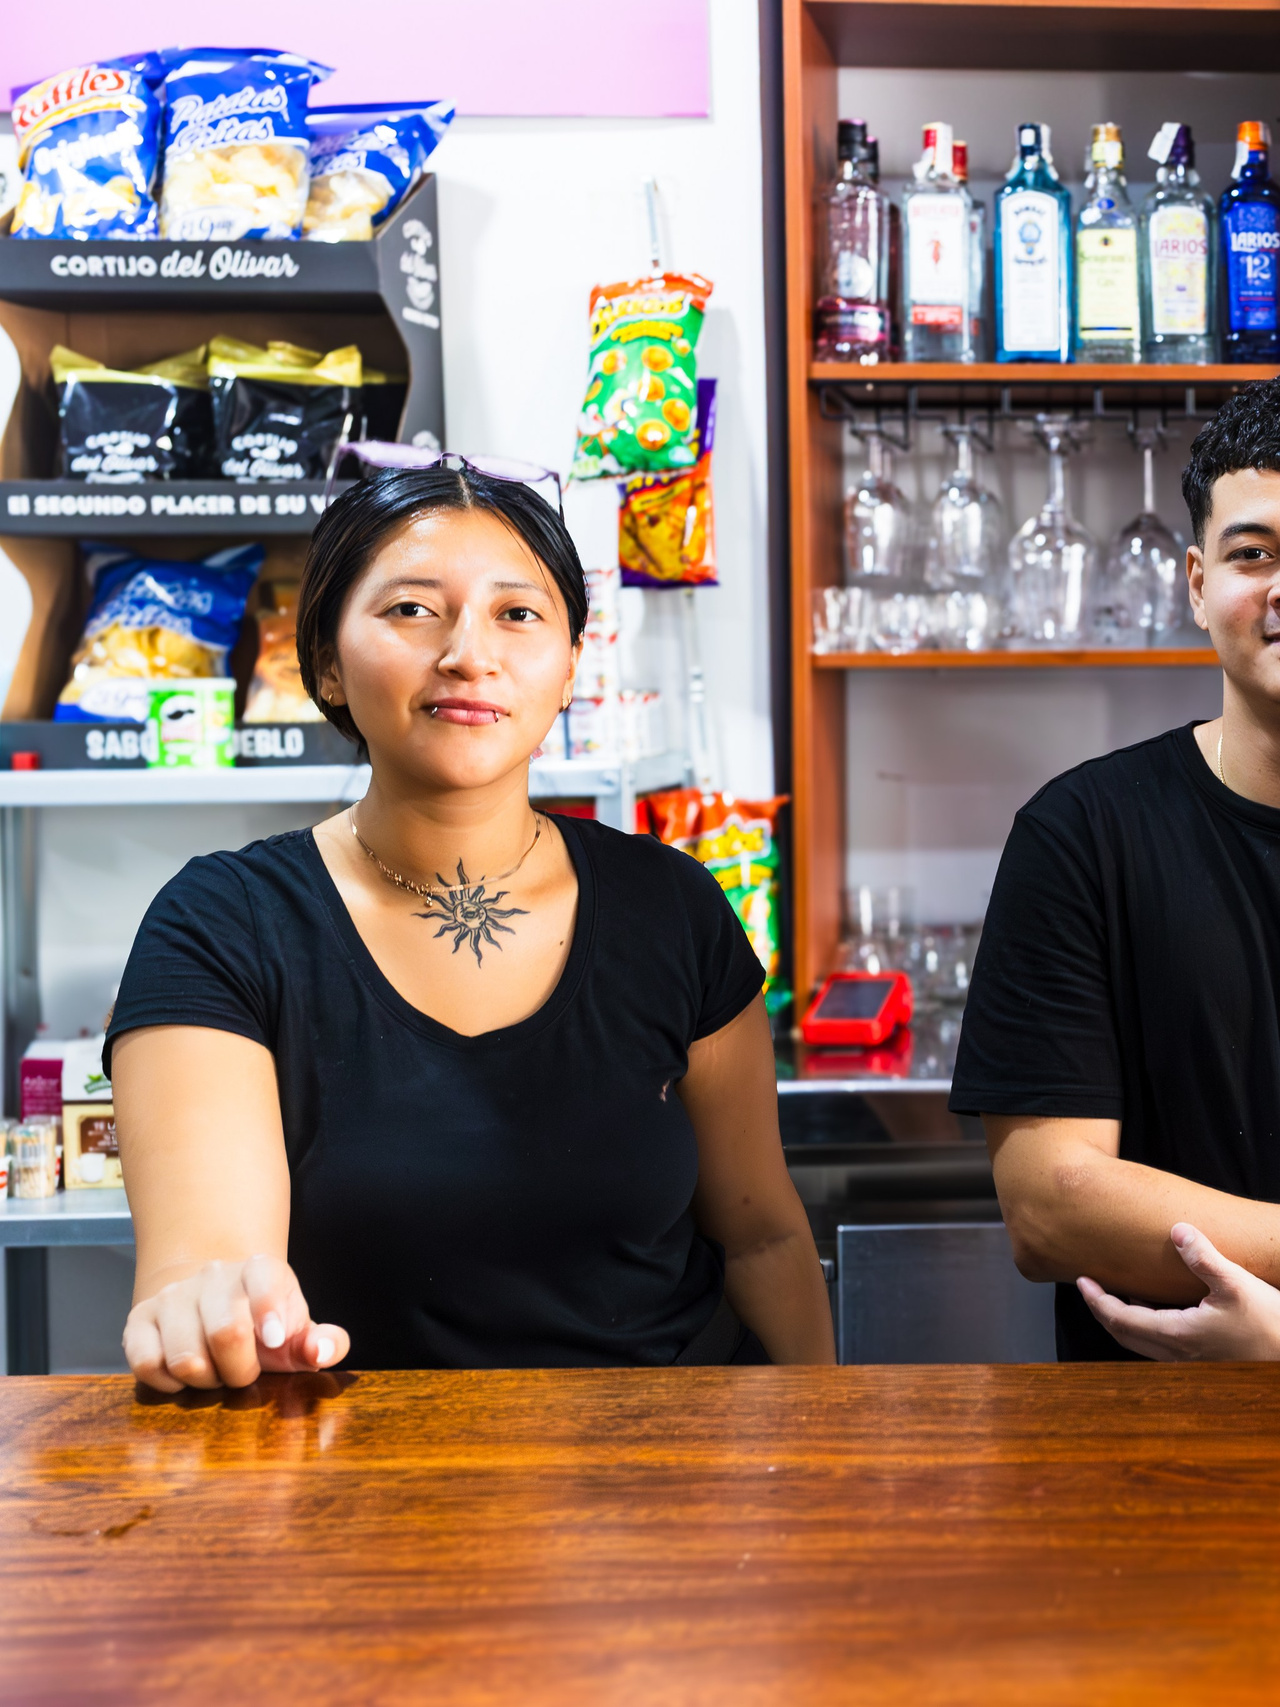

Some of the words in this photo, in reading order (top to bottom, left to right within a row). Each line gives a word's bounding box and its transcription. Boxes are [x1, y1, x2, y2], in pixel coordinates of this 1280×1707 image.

[1155, 239, 1208, 259] LARIOS
[1231, 231, 1280, 252] LARIOS
[50, 255, 158, 277] CORTIJO
[160, 250, 206, 277] del
[209, 246, 300, 281] Olivar
[1246, 254, 1272, 279] 12
[34, 495, 147, 516] SEGUNDO
[151, 495, 236, 515] PLACER
[239, 495, 271, 515] DE
[275, 495, 307, 516] SU
